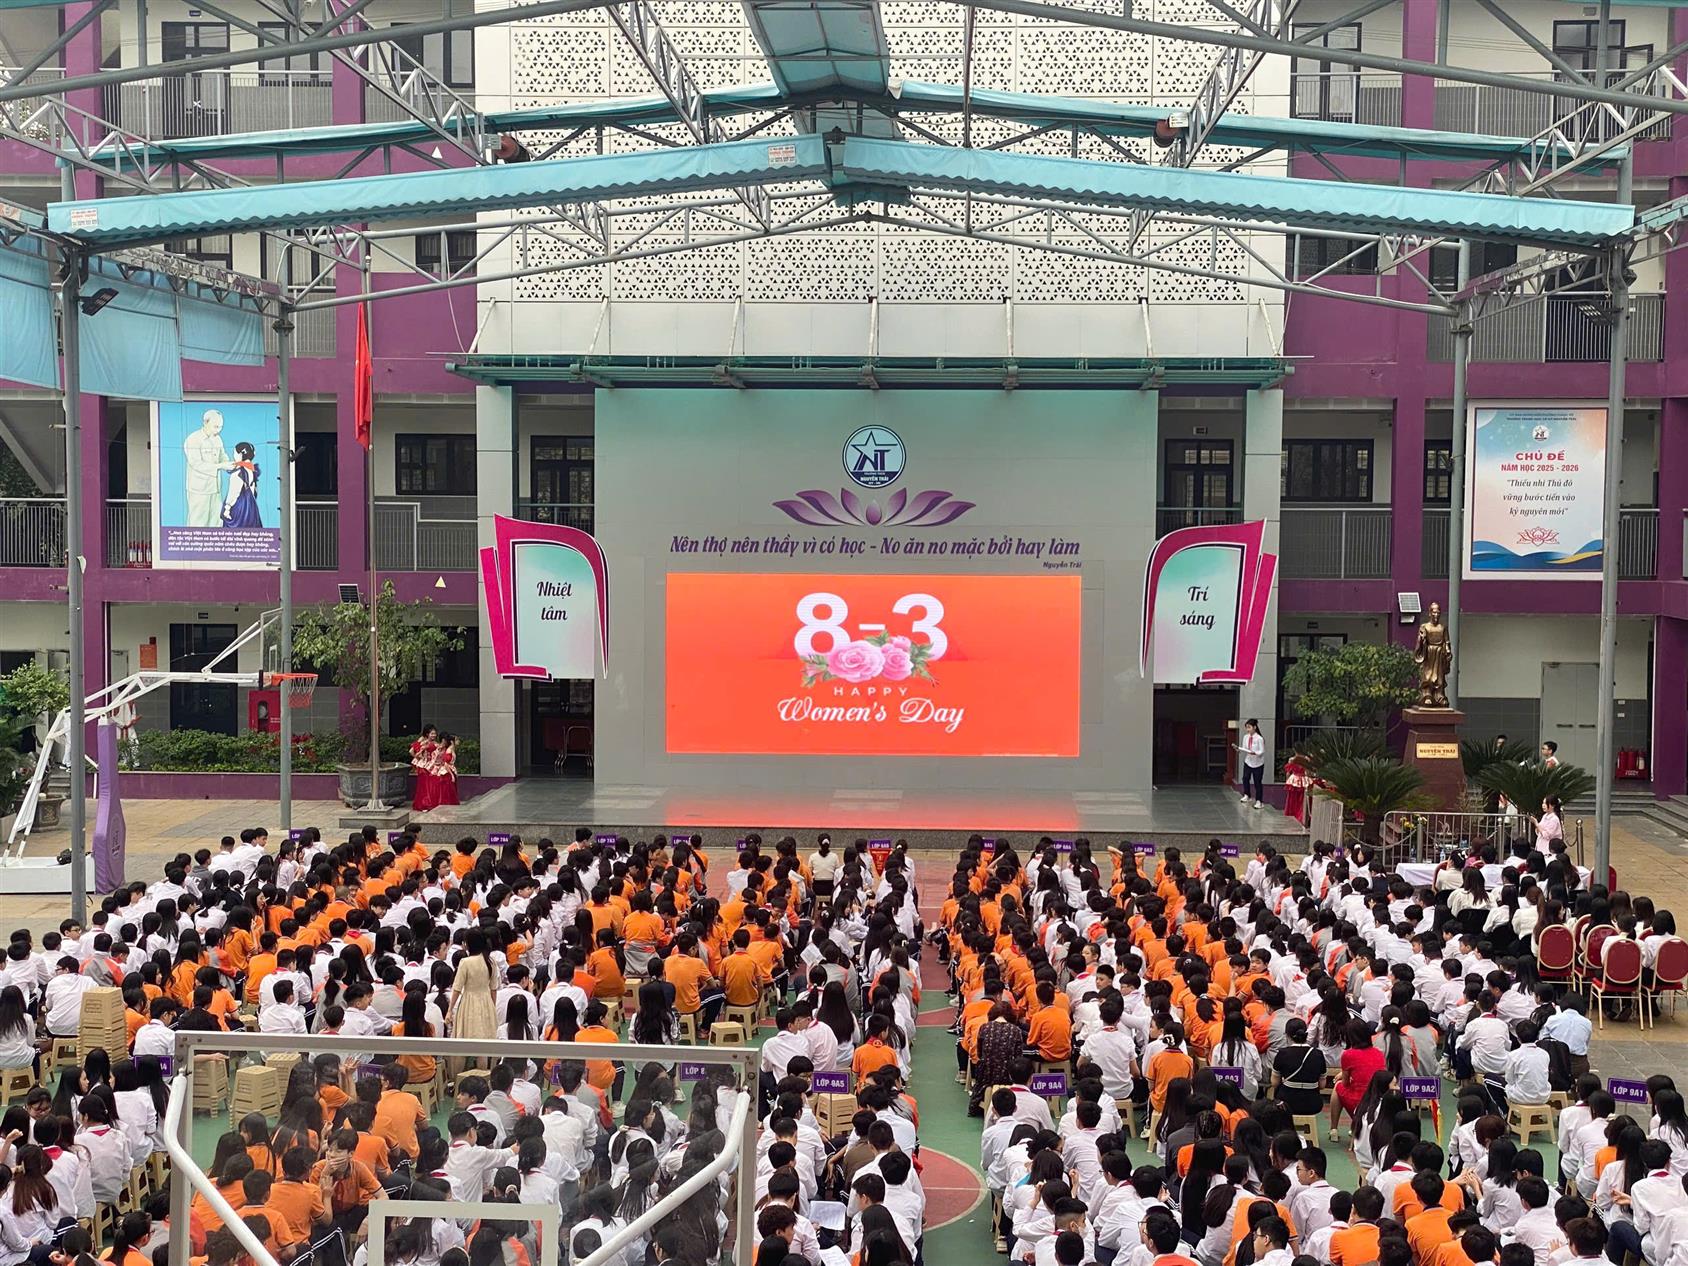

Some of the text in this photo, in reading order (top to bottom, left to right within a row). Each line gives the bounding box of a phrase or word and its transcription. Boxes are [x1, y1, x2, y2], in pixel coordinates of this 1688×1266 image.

[1537, 464, 1554, 472] 2025
[1561, 464, 1579, 472] 2026
[670, 536, 698, 553] Nên
[702, 536, 727, 557] thợ
[731, 536, 760, 553] nên
[763, 534, 799, 558] thầy
[803, 536, 817, 553] vì
[820, 536, 835, 554] có
[839, 537, 866, 558] học
[880, 537, 900, 554] No
[903, 538, 925, 555] ăn
[928, 541, 948, 555] no
[950, 538, 985, 559] mặc
[987, 535, 1013, 555] bởi
[1015, 538, 1045, 559] hay
[1048, 538, 1081, 555] làm
[537, 581, 572, 599] Nhiệt
[1187, 586, 1209, 601] Trí
[541, 606, 568, 621] tâm
[1180, 610, 1216, 630] sáng
[834, 687, 908, 696] HAPPY
[777, 697, 965, 733] Women's Day
[685, 1066, 699, 1075] LỚP
[816, 1077, 845, 1088] LỚP 9A5
[1033, 1080, 1062, 1090] LỚP 9A4
[1406, 1083, 1435, 1093] LỚP 9A2
[1613, 1085, 1643, 1098] LỚP 9A1
